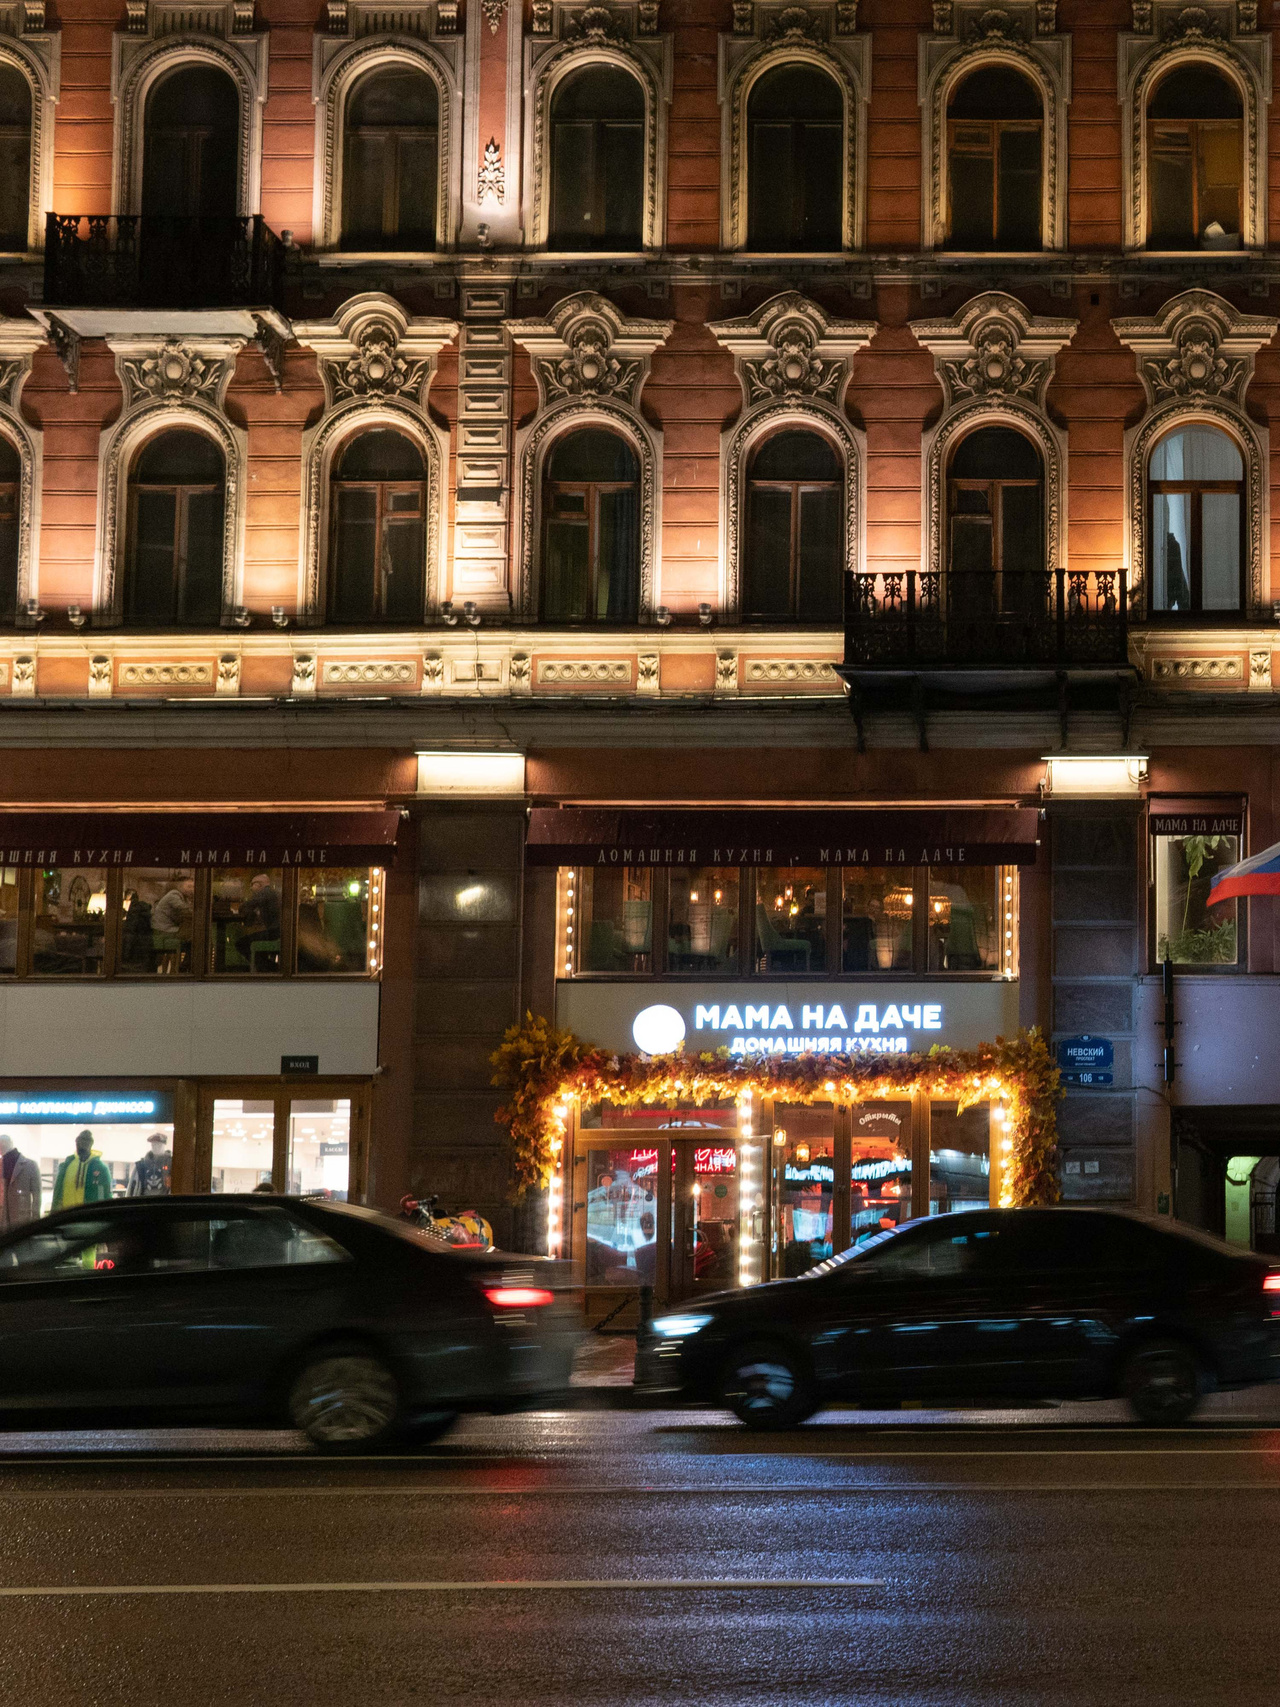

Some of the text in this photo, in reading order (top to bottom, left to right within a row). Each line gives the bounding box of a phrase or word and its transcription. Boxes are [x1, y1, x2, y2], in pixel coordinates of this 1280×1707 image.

[1155, 818, 1239, 832] МАМА НА ДАЧЕ
[73, 850, 133, 863] КУХНЯ
[180, 850, 231, 863] МАМА
[246, 850, 266, 863] НА
[281, 850, 327, 864] ДАЧЕ
[597, 849, 965, 863] ДОМАШНЯЯ КУХНЯ МАМА НА ДАЧЕ
[695, 1004, 942, 1033] МАМА НА ДАЧЕ
[729, 1037, 908, 1054] ДОМАШНЯЯ КУХНЯ
[1067, 1047, 1104, 1056] НЕВСКИЙ
[289, 1061, 310, 1069] ВХОД
[1079, 1073, 1093, 1083] 106
